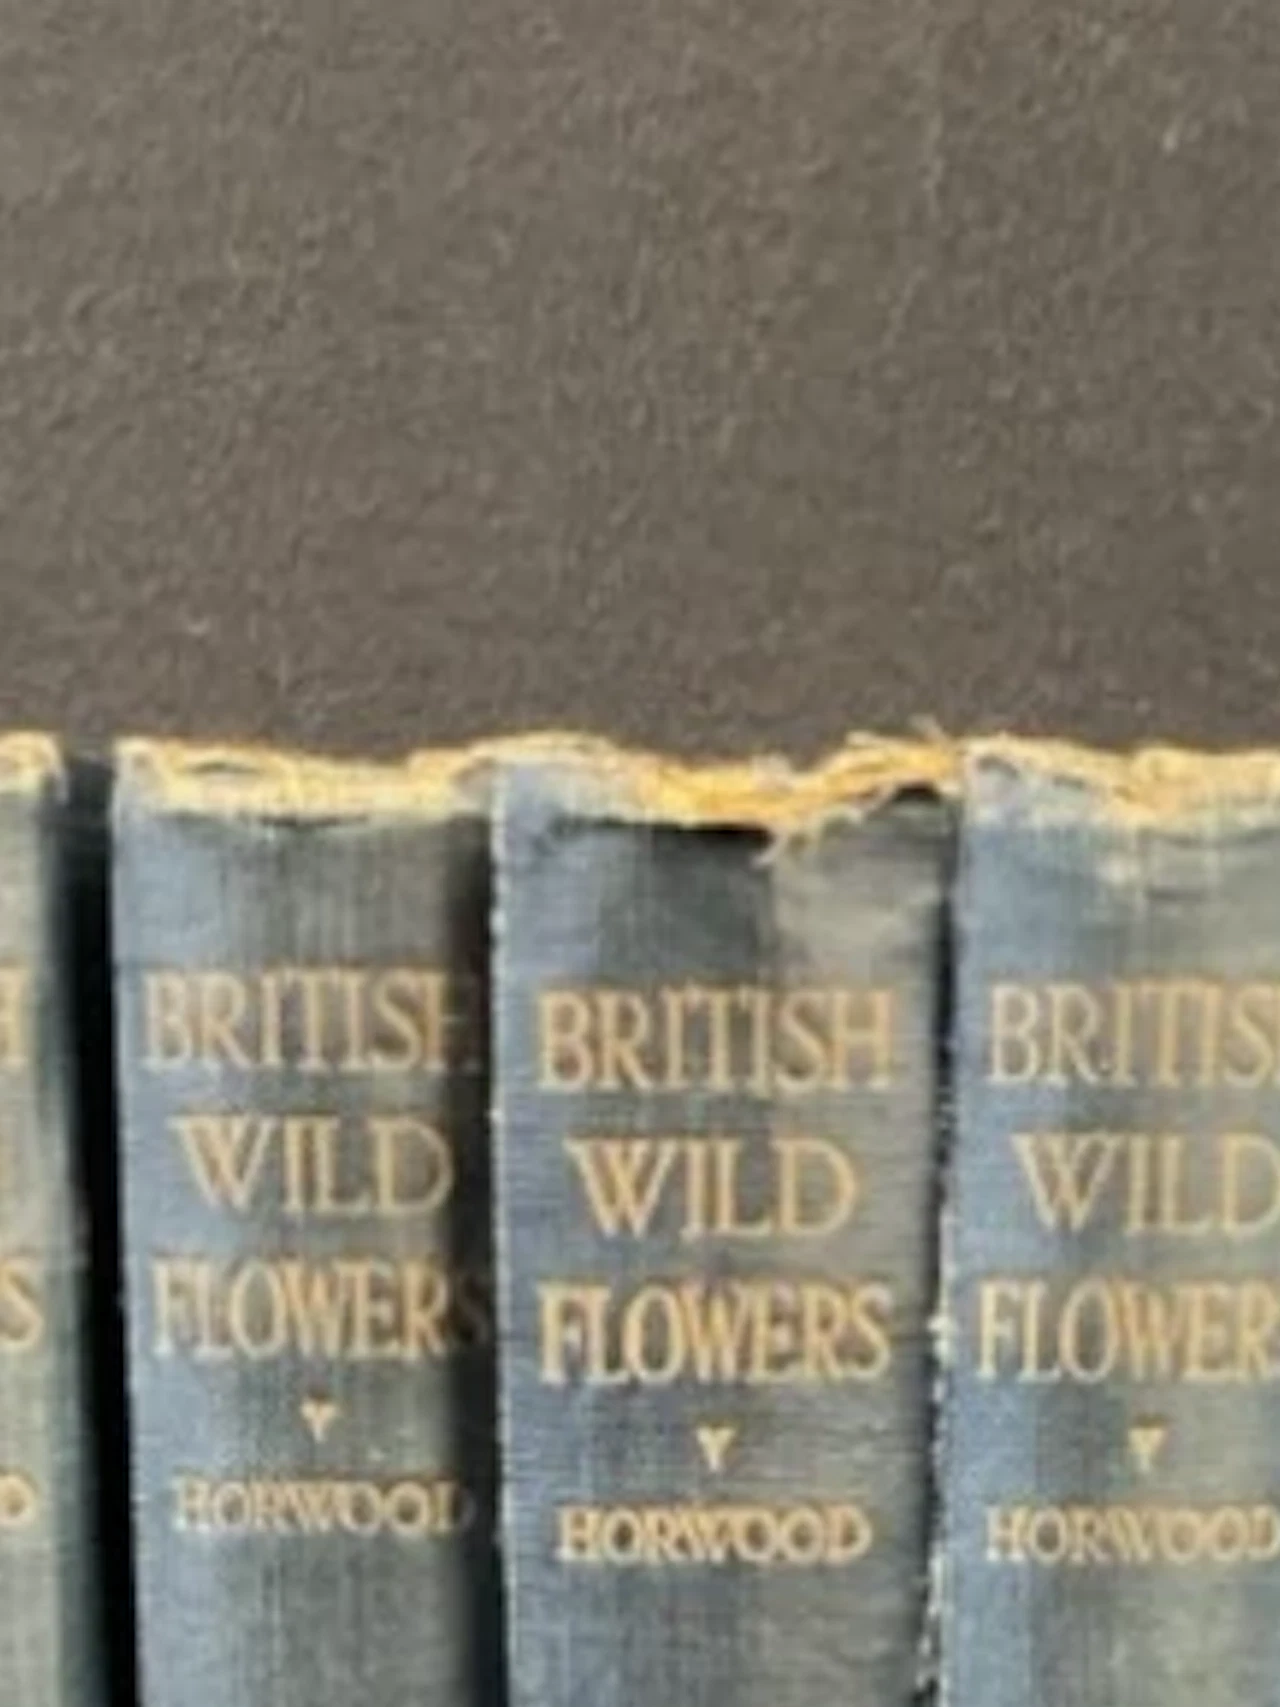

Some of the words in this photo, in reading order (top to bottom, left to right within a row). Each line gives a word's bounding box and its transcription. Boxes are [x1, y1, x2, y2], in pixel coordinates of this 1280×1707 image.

[538, 985, 897, 1092] BRITISH
[170, 1113, 456, 1216] WILD
[565, 1136, 860, 1240] WILD
[535, 1280, 894, 1386] FLOWERS
[555, 1506, 874, 1564] HORWOOD
